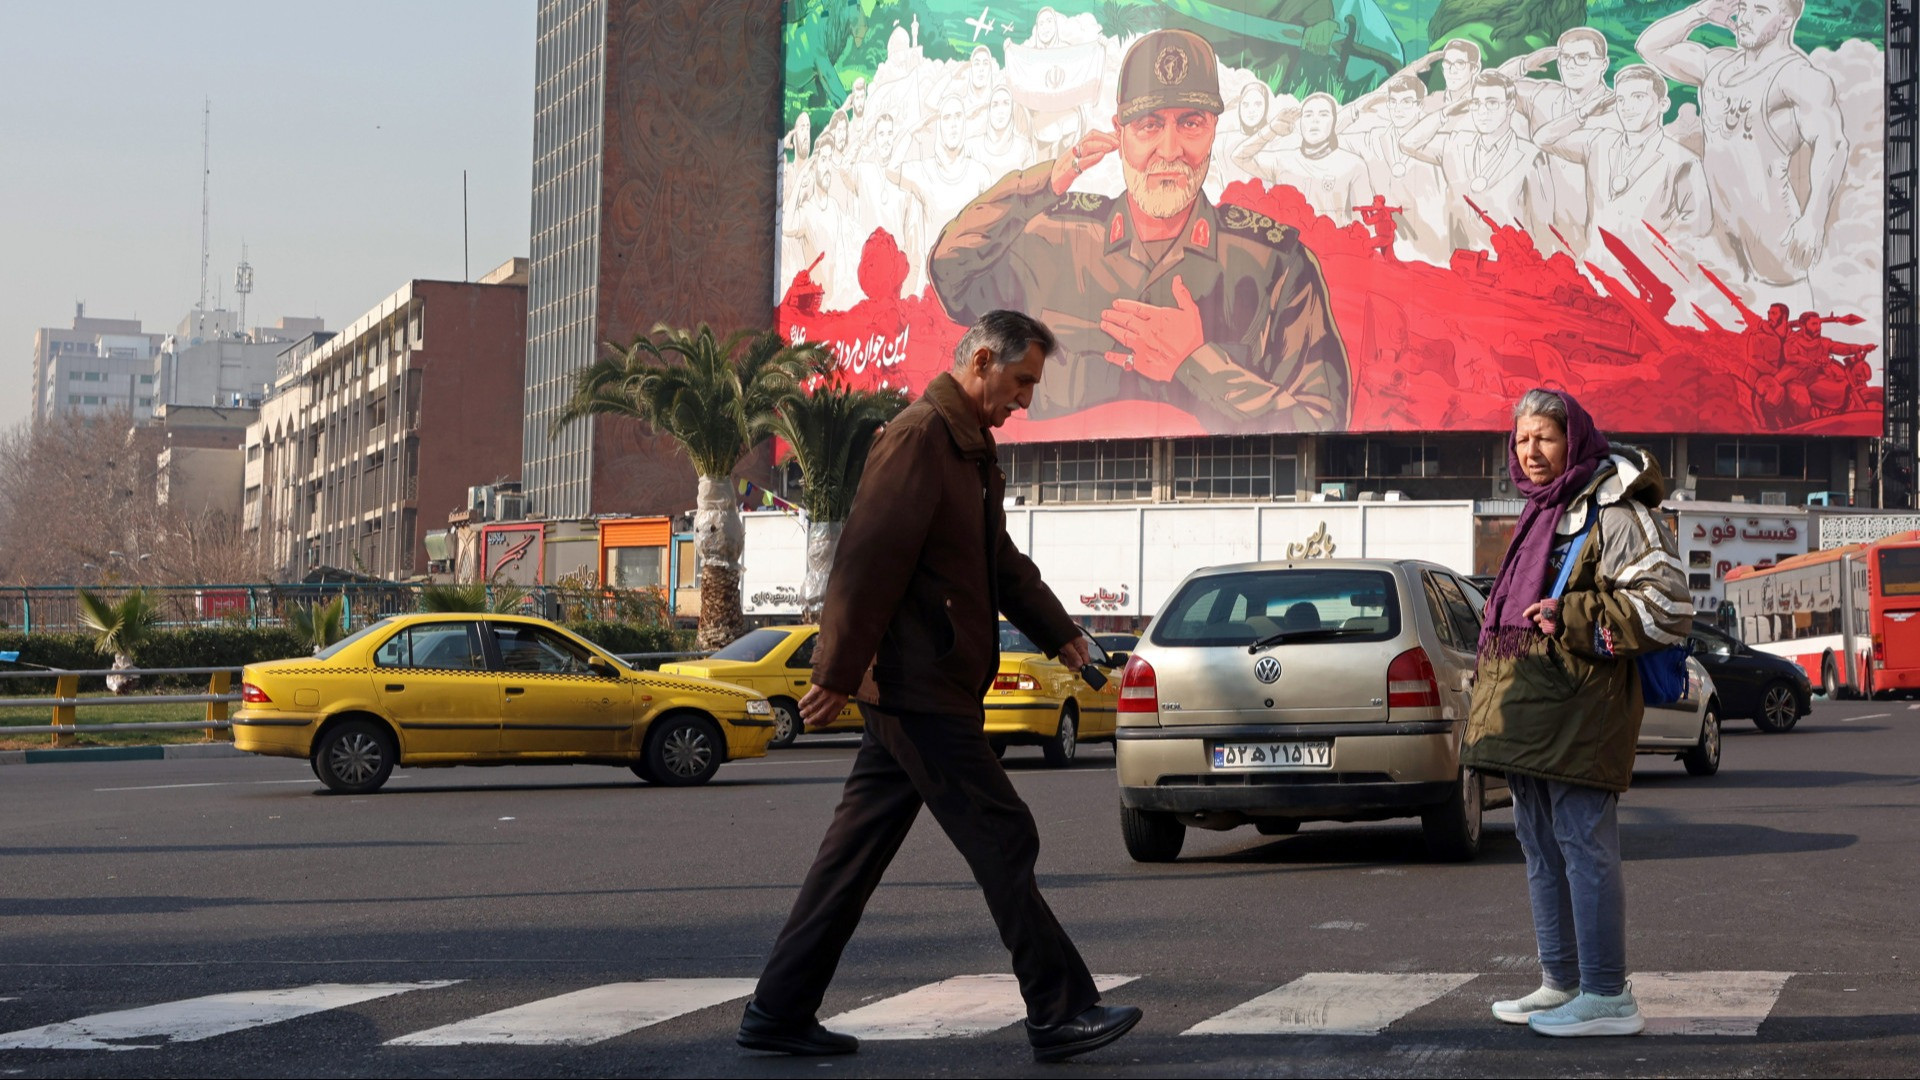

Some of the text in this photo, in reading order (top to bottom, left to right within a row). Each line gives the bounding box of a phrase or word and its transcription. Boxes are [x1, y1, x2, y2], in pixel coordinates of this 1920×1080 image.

[883, 324, 910, 366] این
[1693, 517, 1797, 544] فست فود
[1080, 583, 1126, 608] زیبایی
